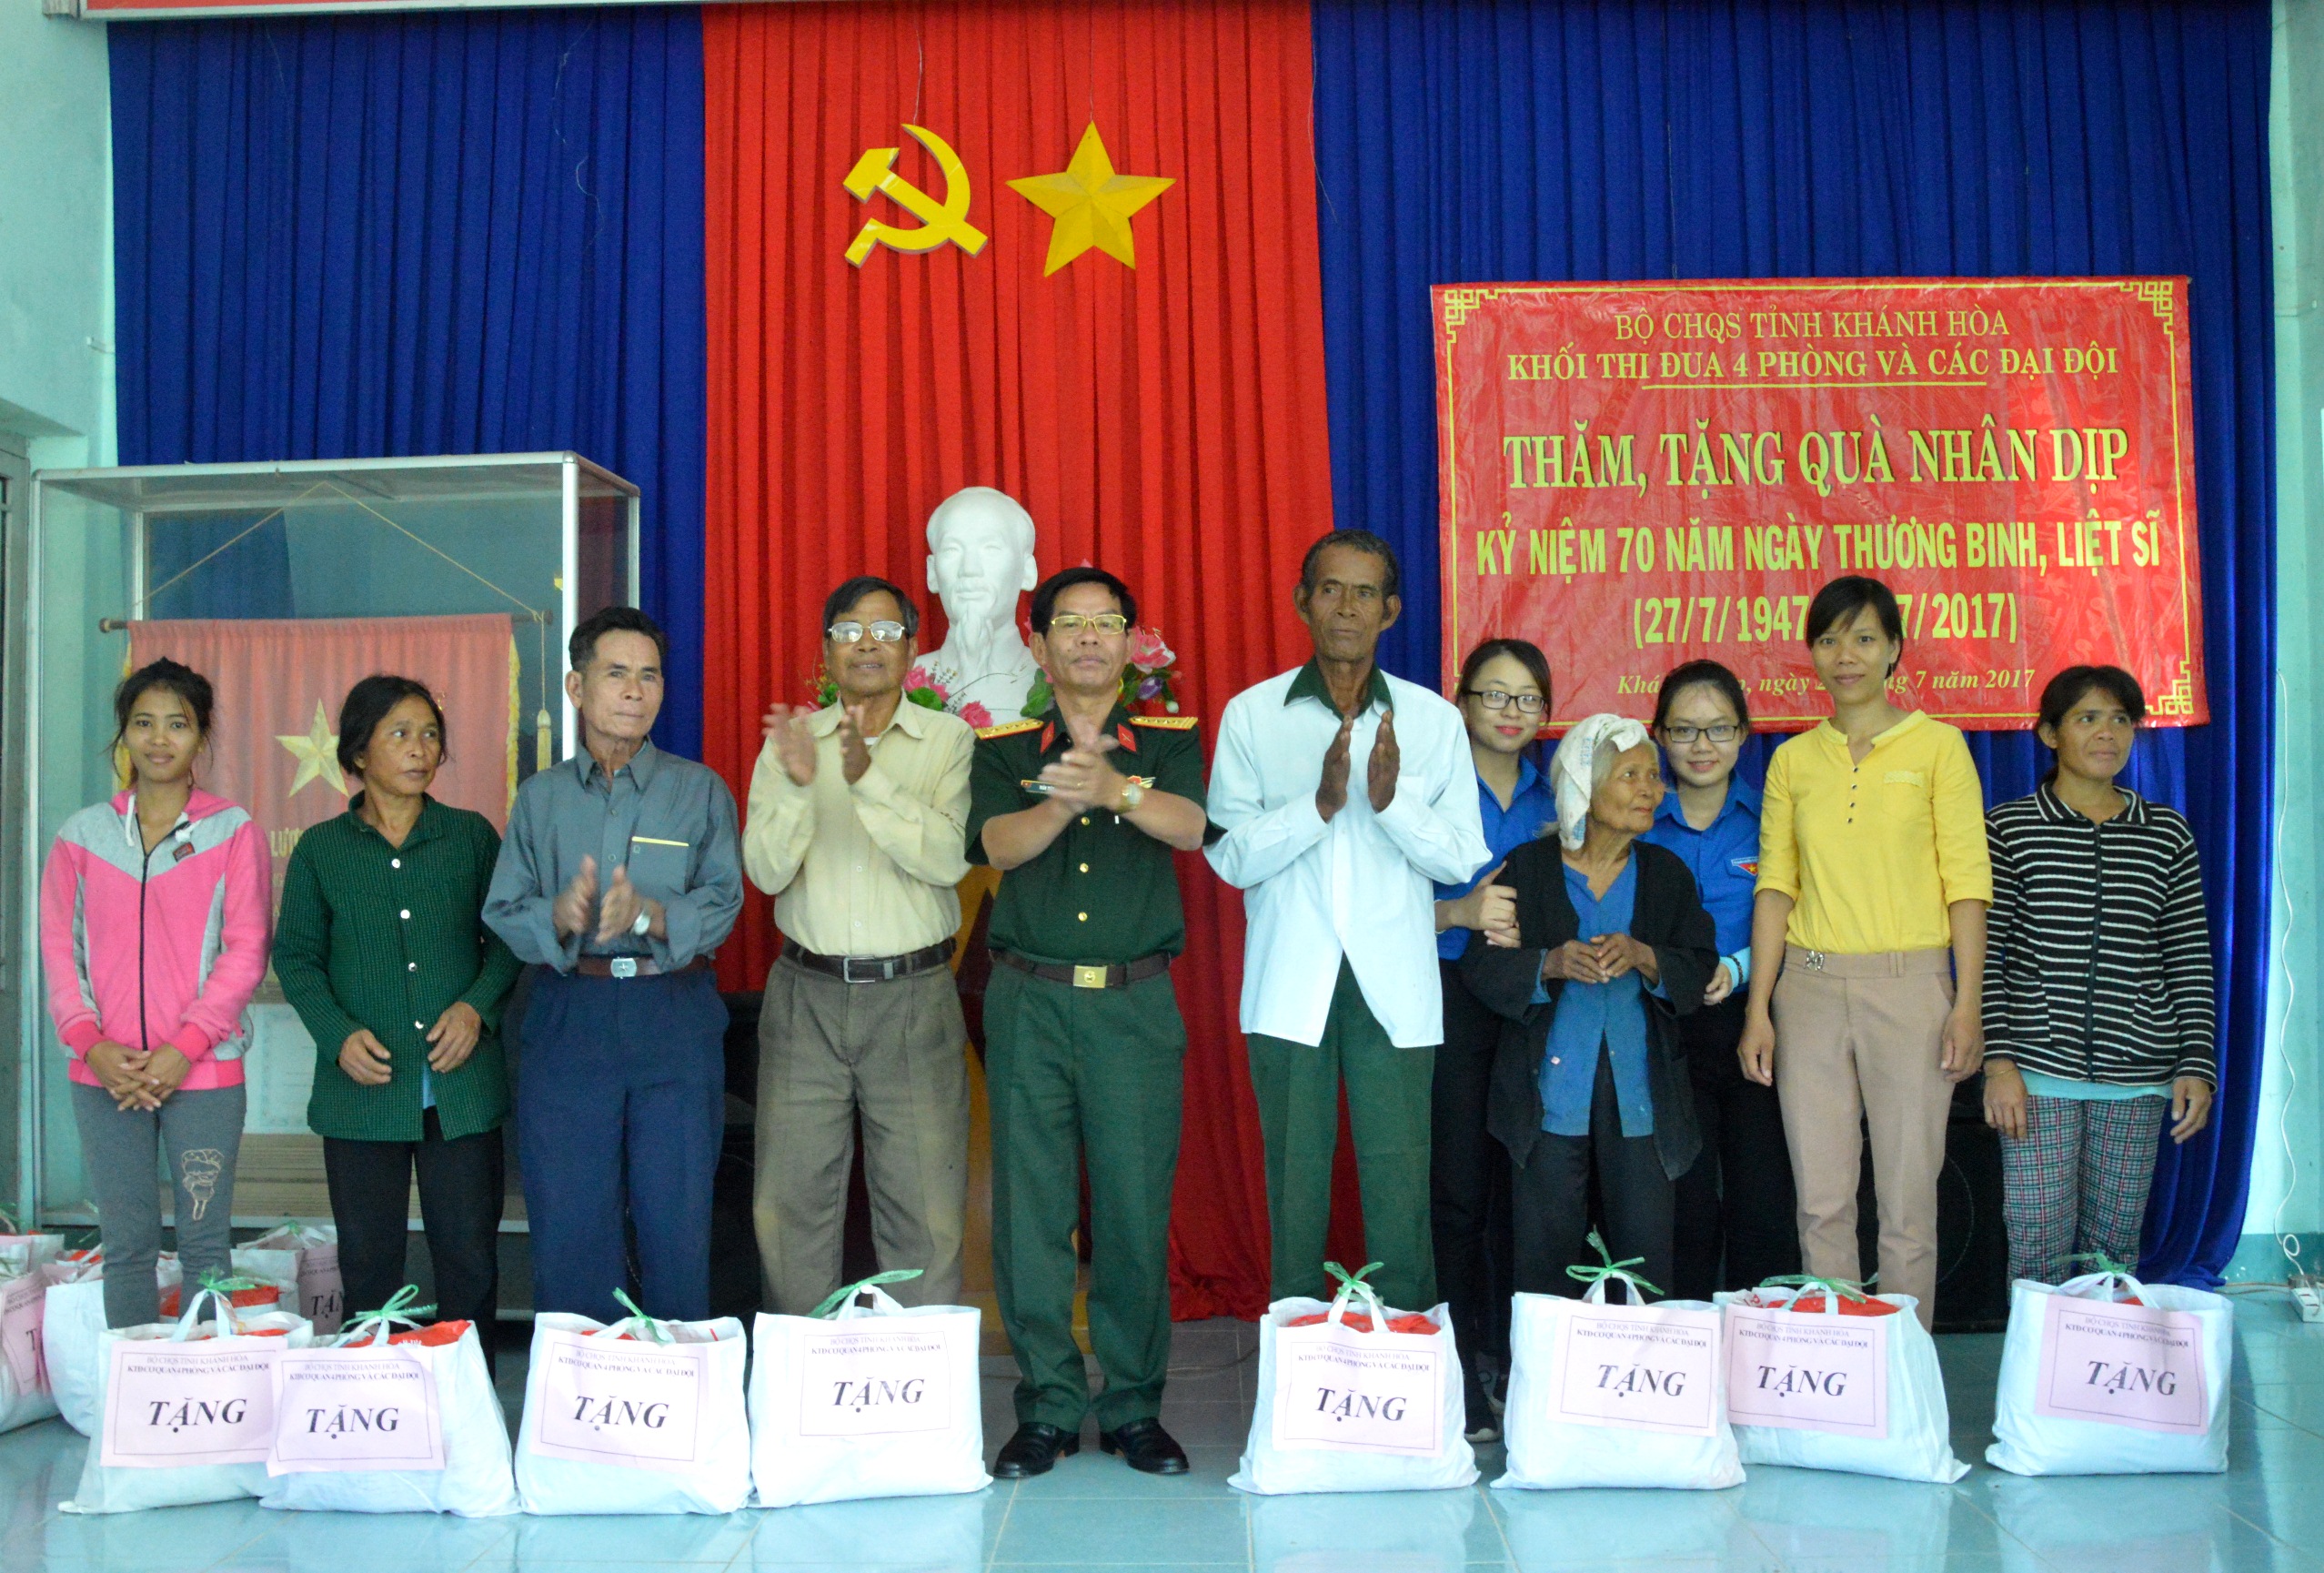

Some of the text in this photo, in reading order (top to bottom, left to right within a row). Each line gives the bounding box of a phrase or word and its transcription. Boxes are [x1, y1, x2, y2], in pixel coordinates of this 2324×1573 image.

[1615, 304, 2009, 344] BỘ CHQS TỈNH KHÁNH HÒA
[1508, 341, 2118, 380] KHỐI THI ĐUA 4 PHÒNG VÀ CÁC ĐẠI ĐỘI
[1504, 414, 2128, 499] THĂM, TẶNG QUÀ NHÂN DỊP
[1477, 508, 2160, 584] KỶ NIỆM 70 NĂM NGÀY THƯƠNG BINH, LIỆT SĨ
[1759, 672, 1810, 696] ngày
[1916, 671, 1927, 688] 7
[1932, 671, 1978, 689] năm
[1986, 669, 2036, 689] 2017
[832, 1376, 924, 1413] TẶNG
[1596, 1364, 1685, 1397] TẶNG
[1756, 1365, 1846, 1397] TẶNG
[2086, 1360, 2176, 1396] TẶNG
[148, 1397, 246, 1433] TẶNG
[306, 1404, 398, 1439] TẶNG
[572, 1395, 669, 1431] TẶNG
[1315, 1386, 1406, 1422] TẶNG
